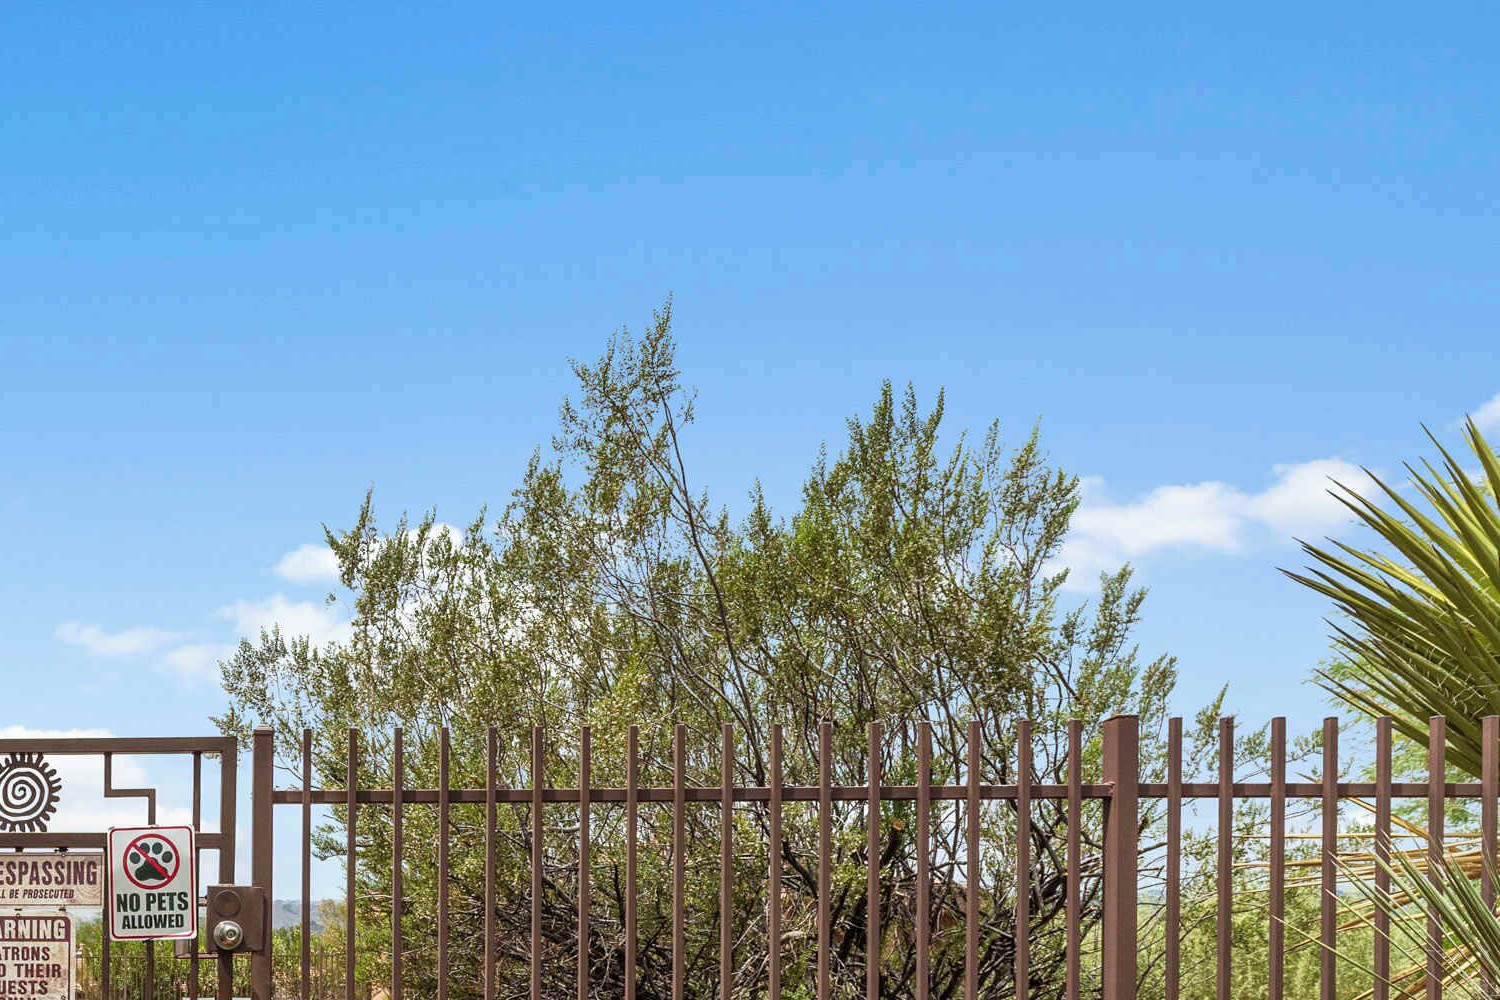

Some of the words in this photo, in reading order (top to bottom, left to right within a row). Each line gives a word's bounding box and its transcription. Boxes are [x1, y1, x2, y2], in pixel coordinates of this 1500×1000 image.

[9, 889, 19, 899] BE
[22, 888, 74, 899] PROSECUTED
[116, 892, 141, 913] NO
[146, 891, 189, 911] PETS
[122, 913, 184, 930] ALLOWED
[14, 963, 62, 978] THEIR
